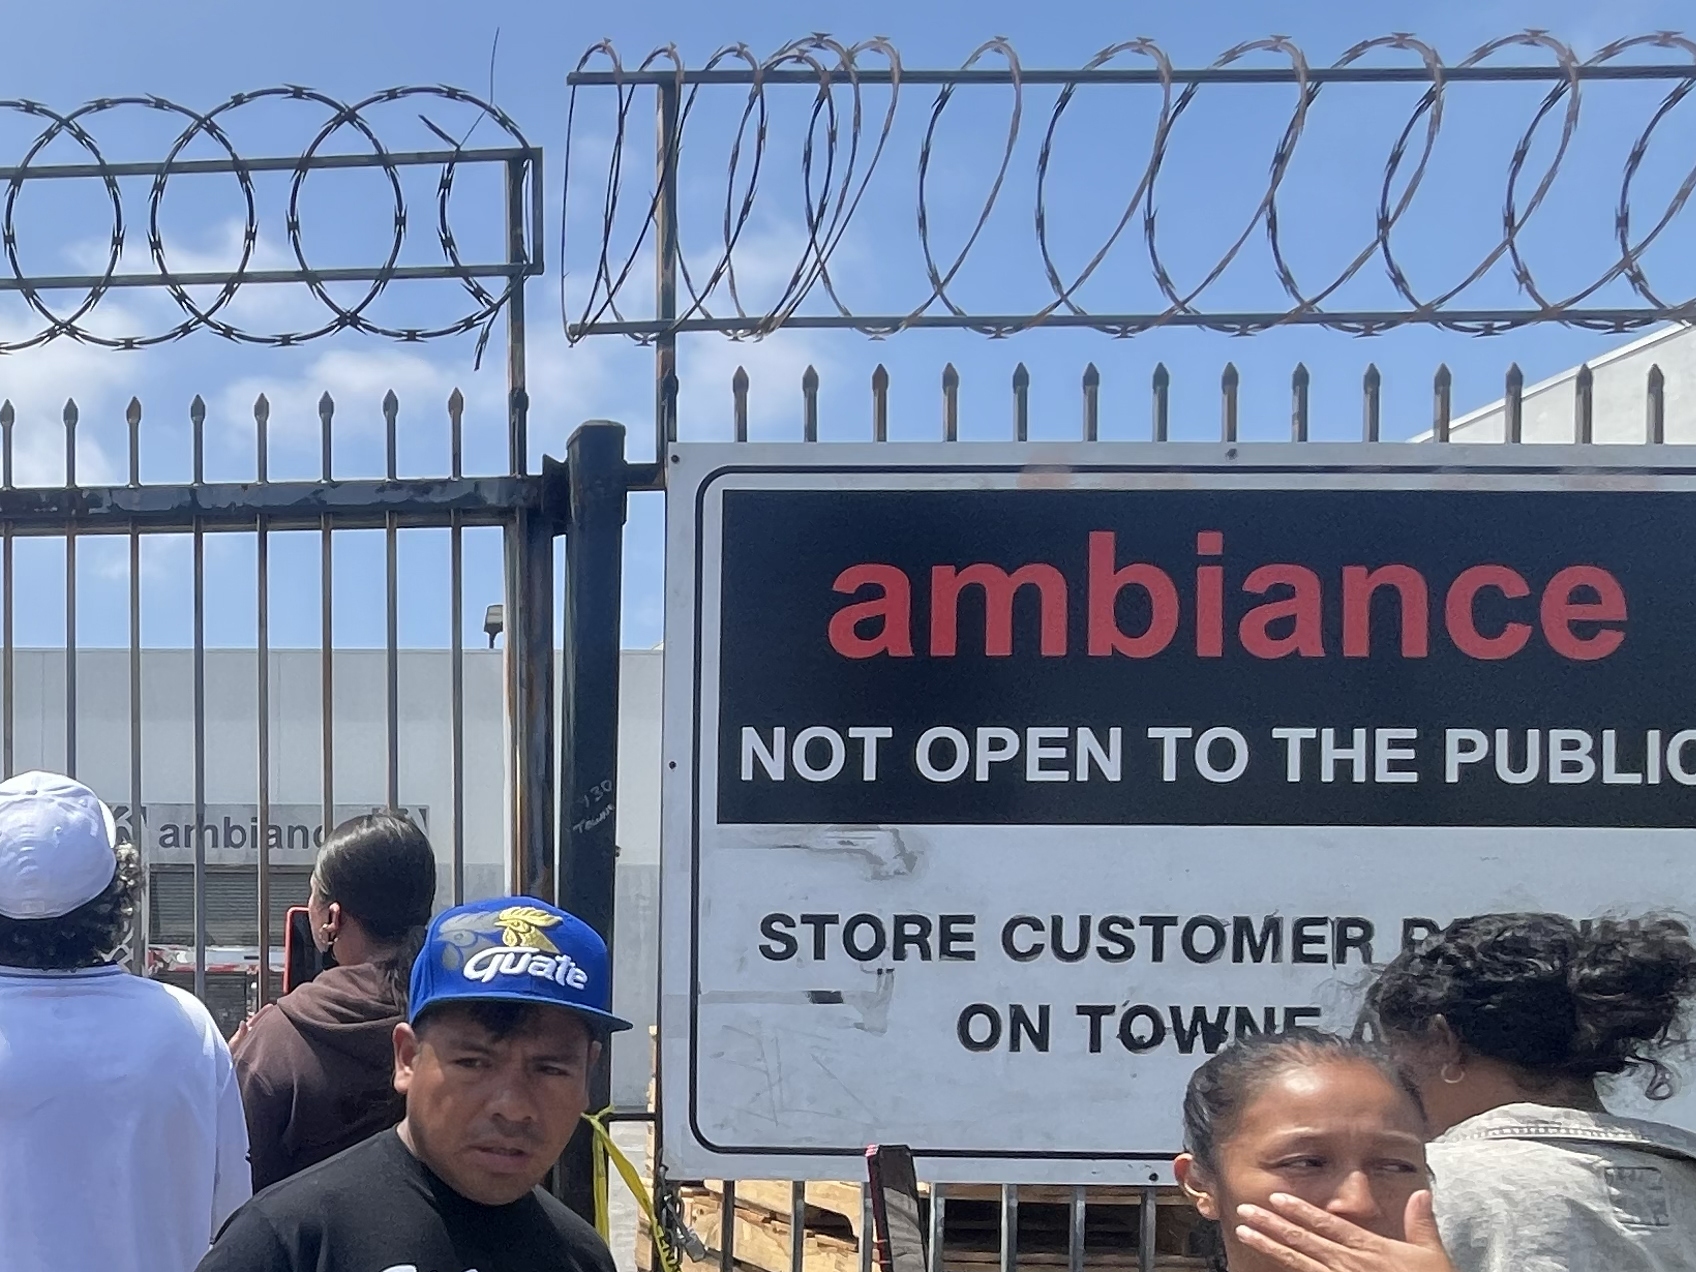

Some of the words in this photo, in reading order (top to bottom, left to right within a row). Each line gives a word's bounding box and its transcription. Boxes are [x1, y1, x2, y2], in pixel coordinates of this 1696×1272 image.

[827, 530, 1628, 661] ambiance
[740, 726, 893, 783] NOT
[915, 726, 1123, 783] OPEN
[1147, 726, 1250, 783] TO
[1271, 727, 1419, 784] THE
[158, 816, 325, 849] ambianc
[758, 913, 976, 963] STORE
[1001, 914, 1374, 965] CUSTOMER
[956, 1003, 1051, 1055] ON
